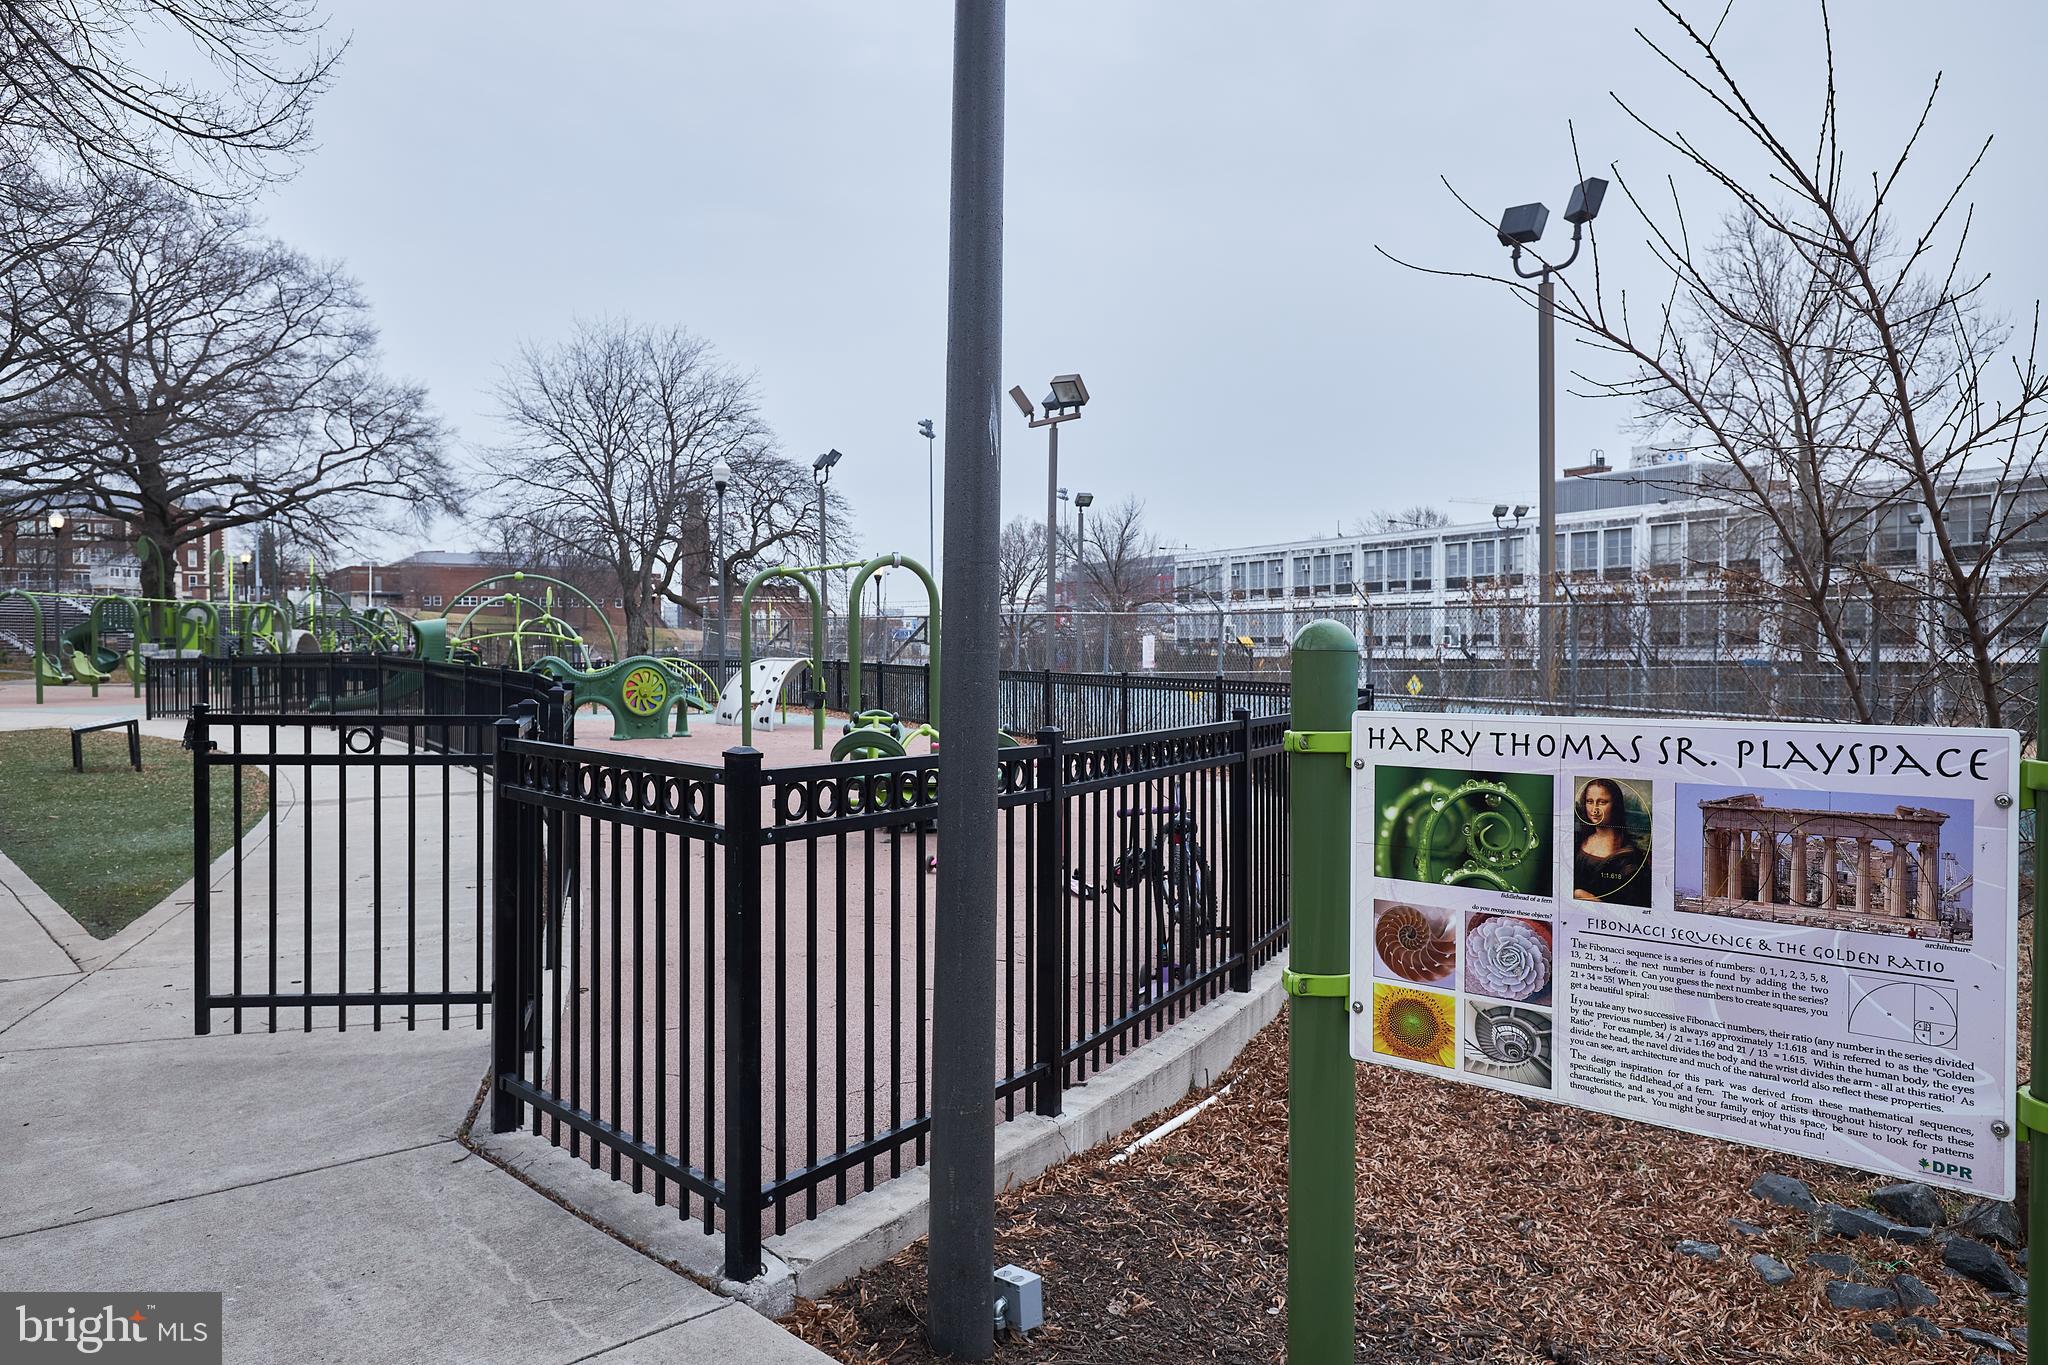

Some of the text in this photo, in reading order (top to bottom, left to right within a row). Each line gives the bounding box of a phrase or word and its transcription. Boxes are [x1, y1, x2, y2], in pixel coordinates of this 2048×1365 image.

[1368, 726, 1989, 781] HARRY THOMAS SR. PLAYSPACE
[1501, 893, 1529, 902] fiddlehead
[1600, 872, 1622, 880] 1:1.618
[1490, 907, 1516, 915] recognize
[1516, 909, 1530, 917] these
[1531, 912, 1552, 920] objects?
[1570, 937, 1587, 949] The
[1588, 942, 1625, 955] Fibonacci
[1626, 949, 1662, 960] sequence
[1679, 956, 1703, 965] series
[1715, 962, 1755, 973] numbers:
[1587, 917, 1944, 973] FIBONACCI SEQUENCE & THE GOLDEN RATIO
[1925, 943, 1971, 953] architecture
[1570, 961, 1603, 972] numbers
[1604, 964, 1629, 976] before
[1630, 968, 1638, 977] it.
[1641, 970, 1657, 980] Can
[1675, 977, 1699, 986] guess
[1700, 979, 1714, 988] the
[1715, 983, 1734, 991] next
[1735, 986, 1770, 997] number
[1782, 991, 1797, 1001] the
[1798, 995, 1828, 1005] series?
[1570, 981, 1582, 989] get
[1589, 982, 1624, 996] beautiful
[1625, 990, 1649, 1000] spiral:
[1578, 999, 1593, 1007] you
[1594, 1000, 1611, 1009] take
[1611, 1004, 1626, 1014] any
[1627, 1006, 1643, 1015] two
[1643, 1009, 1685, 1022] successive
[1686, 1015, 1726, 1029] Fibonacci
[1726, 1023, 1767, 1037] numbers,
[1767, 1028, 1790, 1039] their
[1791, 1034, 1812, 1043] ratio
[1836, 1041, 1874, 1053] number
[1887, 1048, 1903, 1059] the
[1904, 1053, 1933, 1065] series
[1934, 1056, 1974, 1071] divided
[1582, 1008, 1594, 1017] the
[1596, 1012, 1631, 1023] previous
[1632, 1018, 1667, 1031] number)
[1679, 1025, 1708, 1037] always
[1711, 1031, 1773, 1049] approximately
[1776, 1041, 1807, 1053] 1:1.618
[1810, 1048, 1828, 1057] and
[1842, 1053, 1881, 1066] referred
[1912, 1064, 1929, 1075] the
[1569, 1026, 1594, 1037] divide
[1595, 1030, 1608, 1039] the
[1609, 1032, 1630, 1044] head,
[1631, 1037, 1645, 1046] the
[1645, 1041, 1668, 1050] navel
[1669, 1043, 1700, 1056] divides
[1701, 1049, 1715, 1059] the
[1716, 1051, 1738, 1064] body
[1740, 1058, 1757, 1067] and
[1759, 1060, 1773, 1070] the
[1774, 1064, 1798, 1074] wrist
[1799, 1067, 1834, 1081] divides
[1836, 1073, 1851, 1084] the
[1852, 1078, 1872, 1088] arm
[1880, 1082, 1893, 1092] all
[1907, 1086, 1926, 1097] this
[1927, 1092, 1955, 1103] ratio!
[1569, 1037, 1584, 1045] you
[1585, 1040, 1599, 1048] can
[1600, 1043, 1615, 1052] see,
[1616, 1046, 1629, 1055] art,
[1630, 1049, 1678, 1063] architecture
[1679, 1057, 1695, 1066] and
[1696, 1061, 1721, 1071] much
[1733, 1066, 1747, 1076] the
[1748, 1070, 1780, 1082] natural
[1781, 1076, 1809, 1087] world
[1811, 1080, 1830, 1091] also
[1832, 1085, 1861, 1097] reflect
[1863, 1090, 1888, 1102] these
[1890, 1096, 1944, 1113] properties.
[1569, 1047, 1974, 1137] The design inspiration for this park was derived from these mathematical sequences,
[1569, 1071, 1624, 1089] characteristics,
[1627, 1083, 1642, 1092] and
[1656, 1089, 1674, 1098] you
[1677, 1091, 1693, 1102] and
[1696, 1097, 1717, 1107] your
[1720, 1100, 1748, 1115] family
[1751, 1109, 1775, 1120] enjoy
[1779, 1112, 1796, 1123] this
[1799, 1118, 1828, 1131] space,
[1847, 1128, 1868, 1138] sure
[1886, 1134, 1908, 1146] look
[1912, 1139, 1927, 1150] for
[1931, 1145, 1974, 1160] patterns
[1932, 1160, 1972, 1180] DPR
